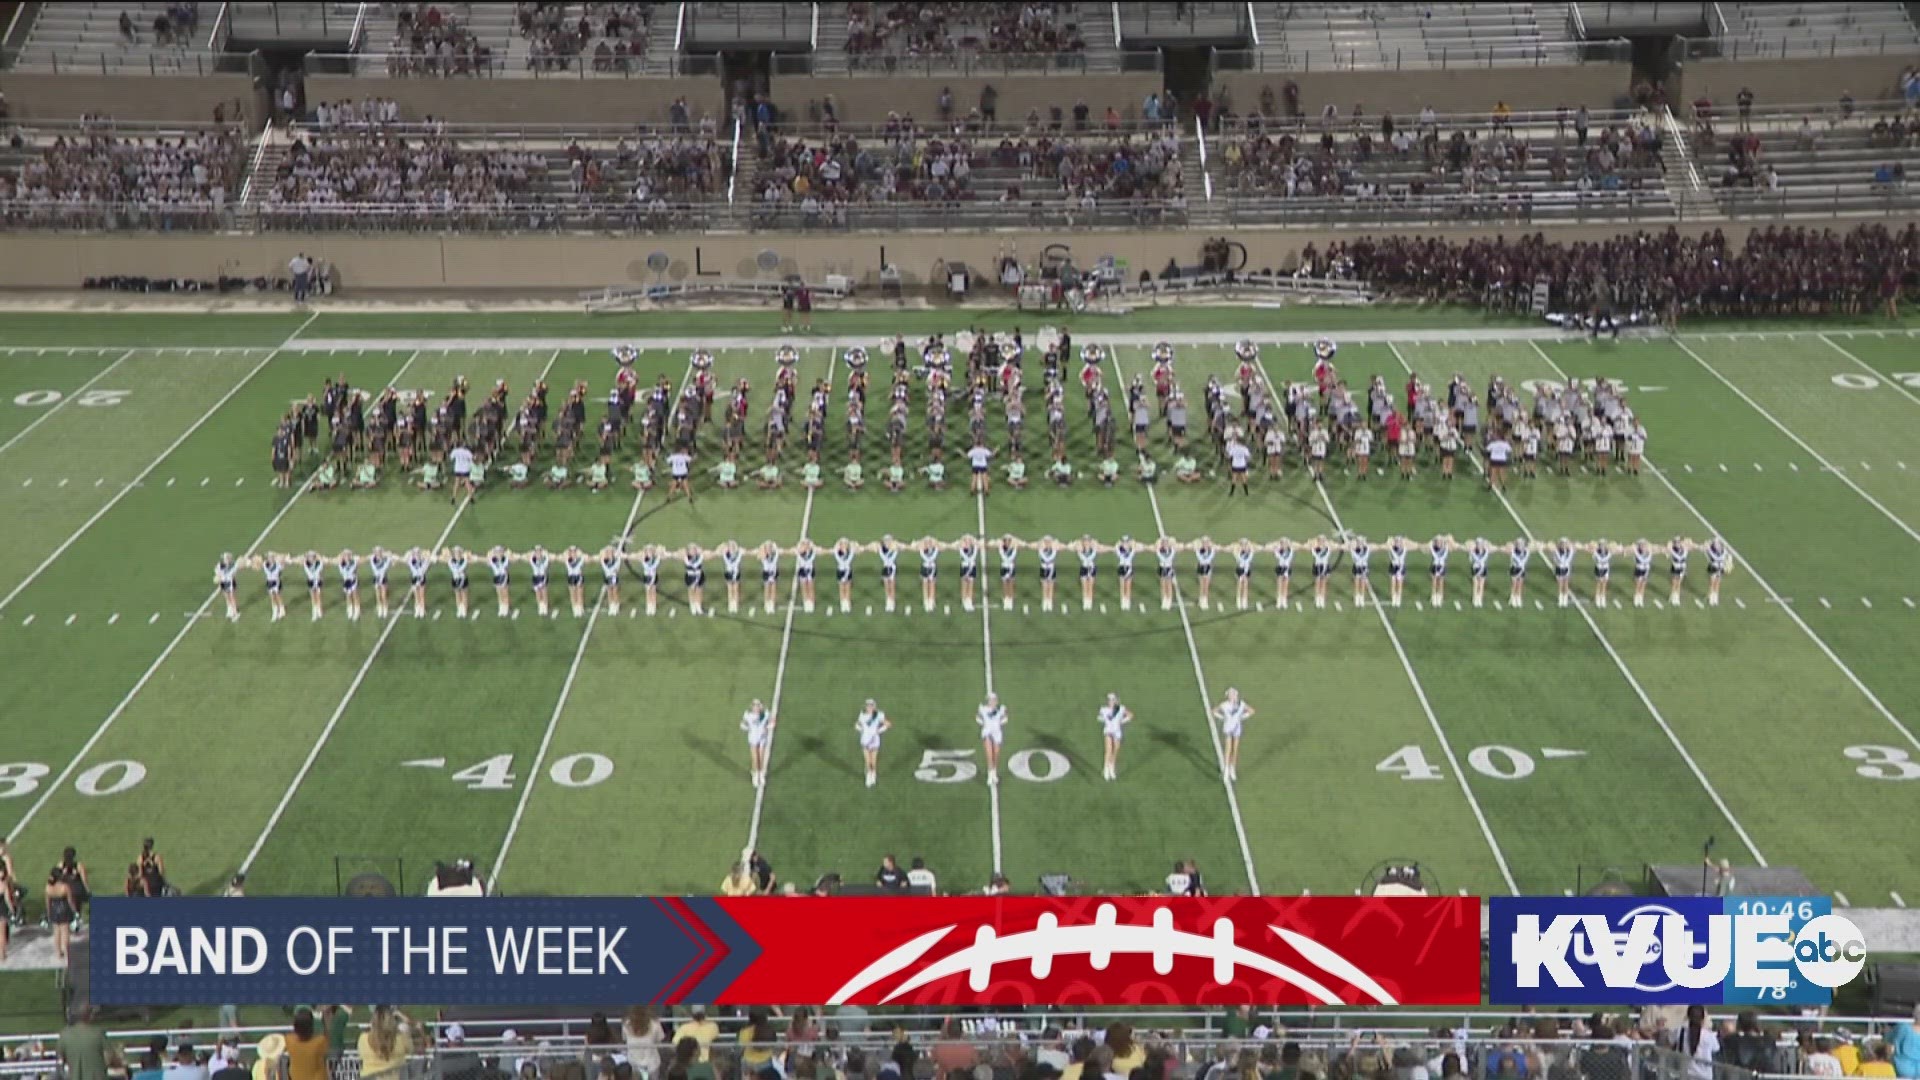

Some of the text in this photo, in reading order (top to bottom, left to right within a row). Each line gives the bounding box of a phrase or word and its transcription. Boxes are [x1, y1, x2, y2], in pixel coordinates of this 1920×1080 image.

[451, 752, 614, 789] 40
[914, 749, 1071, 783] 50
[1375, 745, 1535, 779] 40
